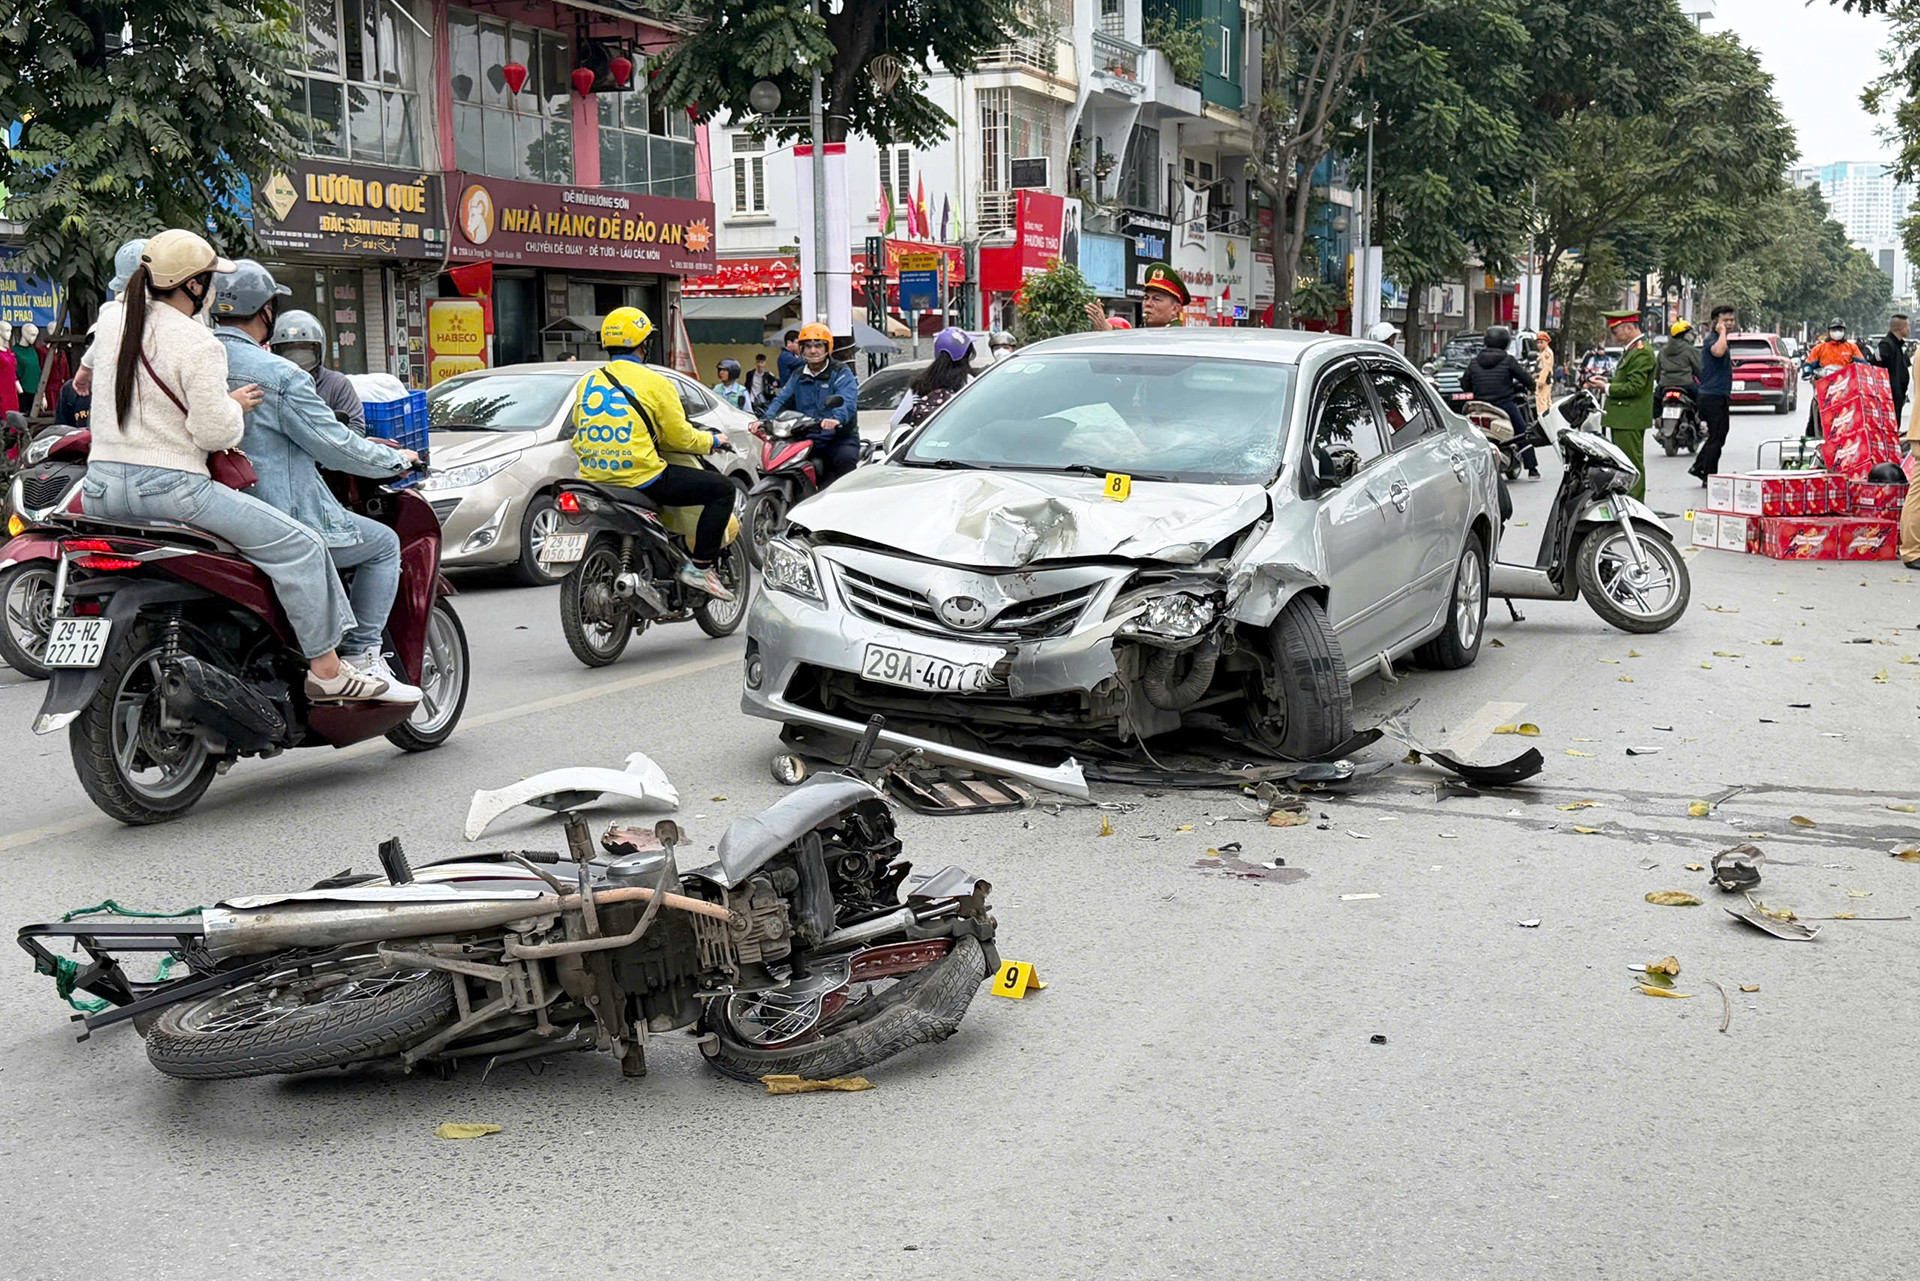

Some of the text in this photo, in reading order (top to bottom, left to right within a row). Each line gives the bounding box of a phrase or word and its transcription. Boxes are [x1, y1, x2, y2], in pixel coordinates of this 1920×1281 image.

[306, 173, 428, 214] LƯƠN O QUẾ
[613, 197, 630, 209] SƠN
[346, 212, 370, 235] SẢN
[371, 217, 401, 242] NGHỆ
[402, 223, 420, 239] AN
[501, 203, 681, 245] NHÀ HÀNG DÊ BẢO AN
[525, 241, 554, 254] CHUYÊN
[554, 241, 563, 254] DÊ
[565, 243, 583, 255] QUAY
[589, 244, 599, 257] DÊ
[600, 246, 615, 257] TƯƠI
[1024, 233, 1058, 250] PHƯƠNG THẢO
[14, 310, 34, 322] PHAO
[437, 333, 477, 343] HABECO
[582, 375, 636, 418] be
[579, 418, 633, 443] Food
[1112, 477, 1122, 492] 8
[57, 622, 100, 641] 29-H2
[46, 644, 99, 664] 227.12
[1004, 966, 1019, 989] 9
